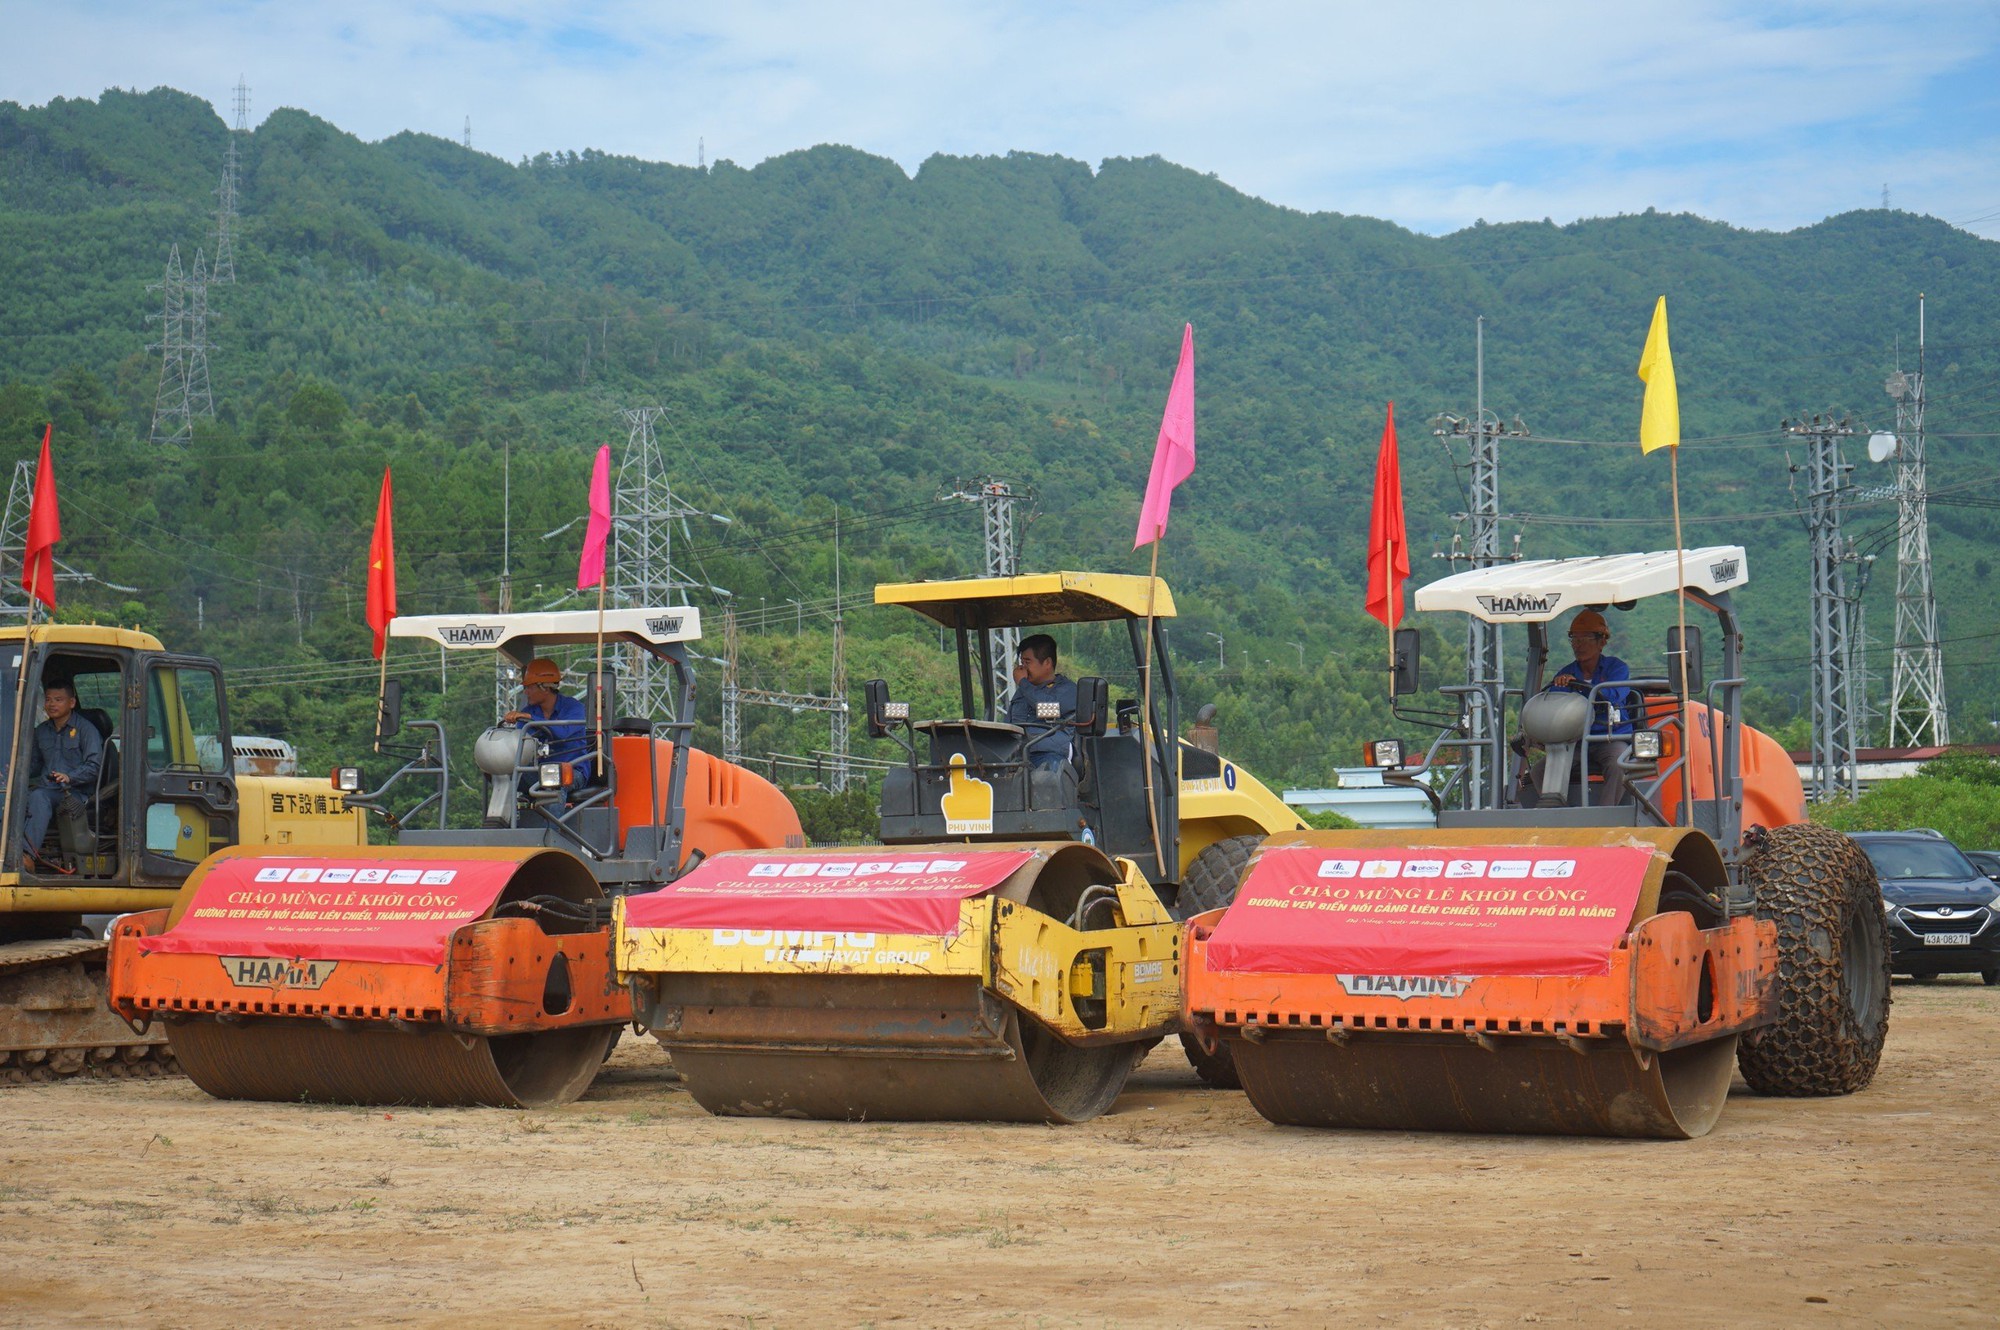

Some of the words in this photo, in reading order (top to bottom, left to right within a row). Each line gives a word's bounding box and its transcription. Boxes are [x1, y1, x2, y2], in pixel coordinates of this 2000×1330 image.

[1715, 563, 1736, 580] HAMM
[1491, 598, 1548, 612] HAMM
[652, 619, 678, 632] HAMM
[450, 629, 494, 642] HAMM
[1226, 769, 1232, 786] 1
[228, 889, 276, 904] CHÀO
[278, 890, 332, 906] MỪNG
[359, 892, 404, 906] KHỞI
[407, 892, 458, 907] CÔNG
[1288, 885, 1350, 900] CHÀO
[1354, 886, 1422, 900] MỪNG
[1460, 887, 1516, 902] KHỞI
[1523, 886, 1588, 902] CÔNG
[228, 909, 249, 918] VEN
[318, 910, 342, 920] LIÊN
[376, 910, 408, 920] THÀNH
[1292, 900, 1316, 910] VEN
[1374, 902, 1410, 914] CẢNG
[1410, 904, 1439, 914] LIÊN
[1486, 905, 1528, 916] THÀNH
[1529, 904, 1558, 916] PHỐ
[1926, 934, 1969, 944] 43A-082.71
[823, 950, 870, 962] FAYAT
[875, 951, 930, 964] GROUP
[1134, 962, 1162, 976] BOMAG
